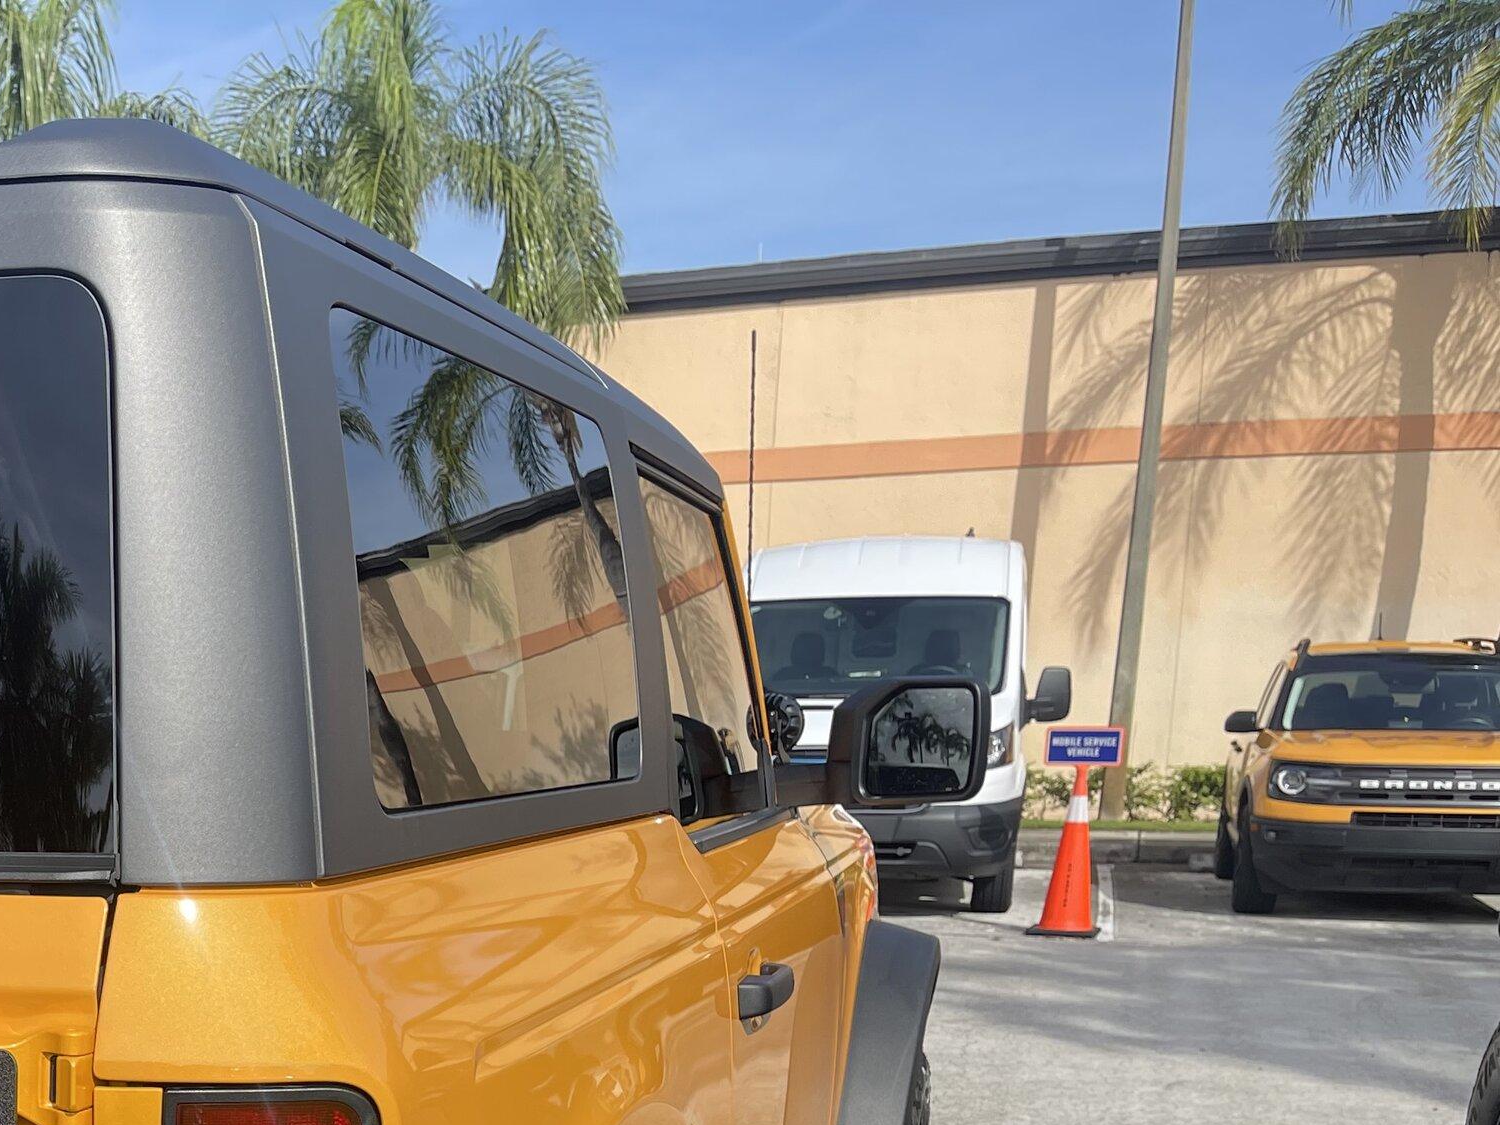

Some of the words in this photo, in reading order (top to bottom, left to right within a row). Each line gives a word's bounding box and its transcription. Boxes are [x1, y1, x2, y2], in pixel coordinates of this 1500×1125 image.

[1052, 736, 1082, 747] MOBILE
[1083, 736, 1117, 747] SERVICE
[1066, 747, 1100, 758] VEHICLE
[1359, 779, 1500, 791] BRONCO
